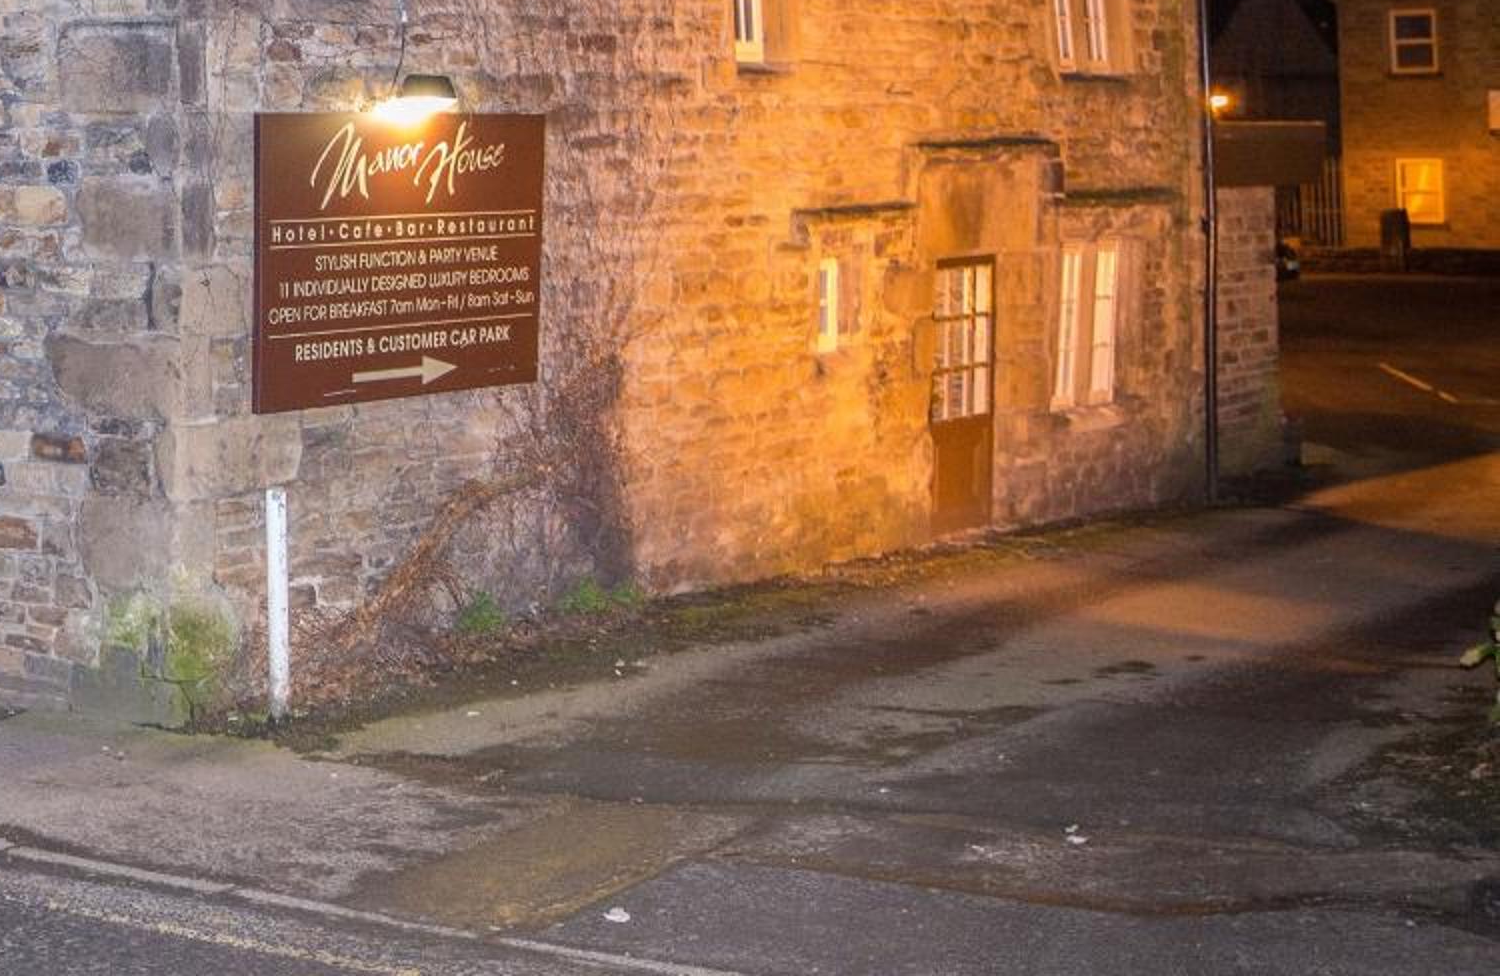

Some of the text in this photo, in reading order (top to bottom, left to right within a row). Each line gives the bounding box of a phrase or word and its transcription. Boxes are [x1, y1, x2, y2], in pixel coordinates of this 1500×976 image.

[310, 120, 505, 211] Manor House
[271, 214, 534, 243] Hotel Cafe Bar Restaurant
[315, 244, 499, 272] STYLISH FUNCTION & PARTY VENUE
[279, 266, 530, 299] 11 INDIVIDUALLY DESIGNED LUXURY BEDROOMS
[268, 306, 302, 325] OPEN
[303, 304, 328, 322] FOR
[329, 299, 389, 319] BREAKFAST
[390, 299, 415, 315] 7am
[467, 292, 491, 309] 8am
[295, 324, 512, 362] RESIDENTS & CUSTOMER CAR PARK
